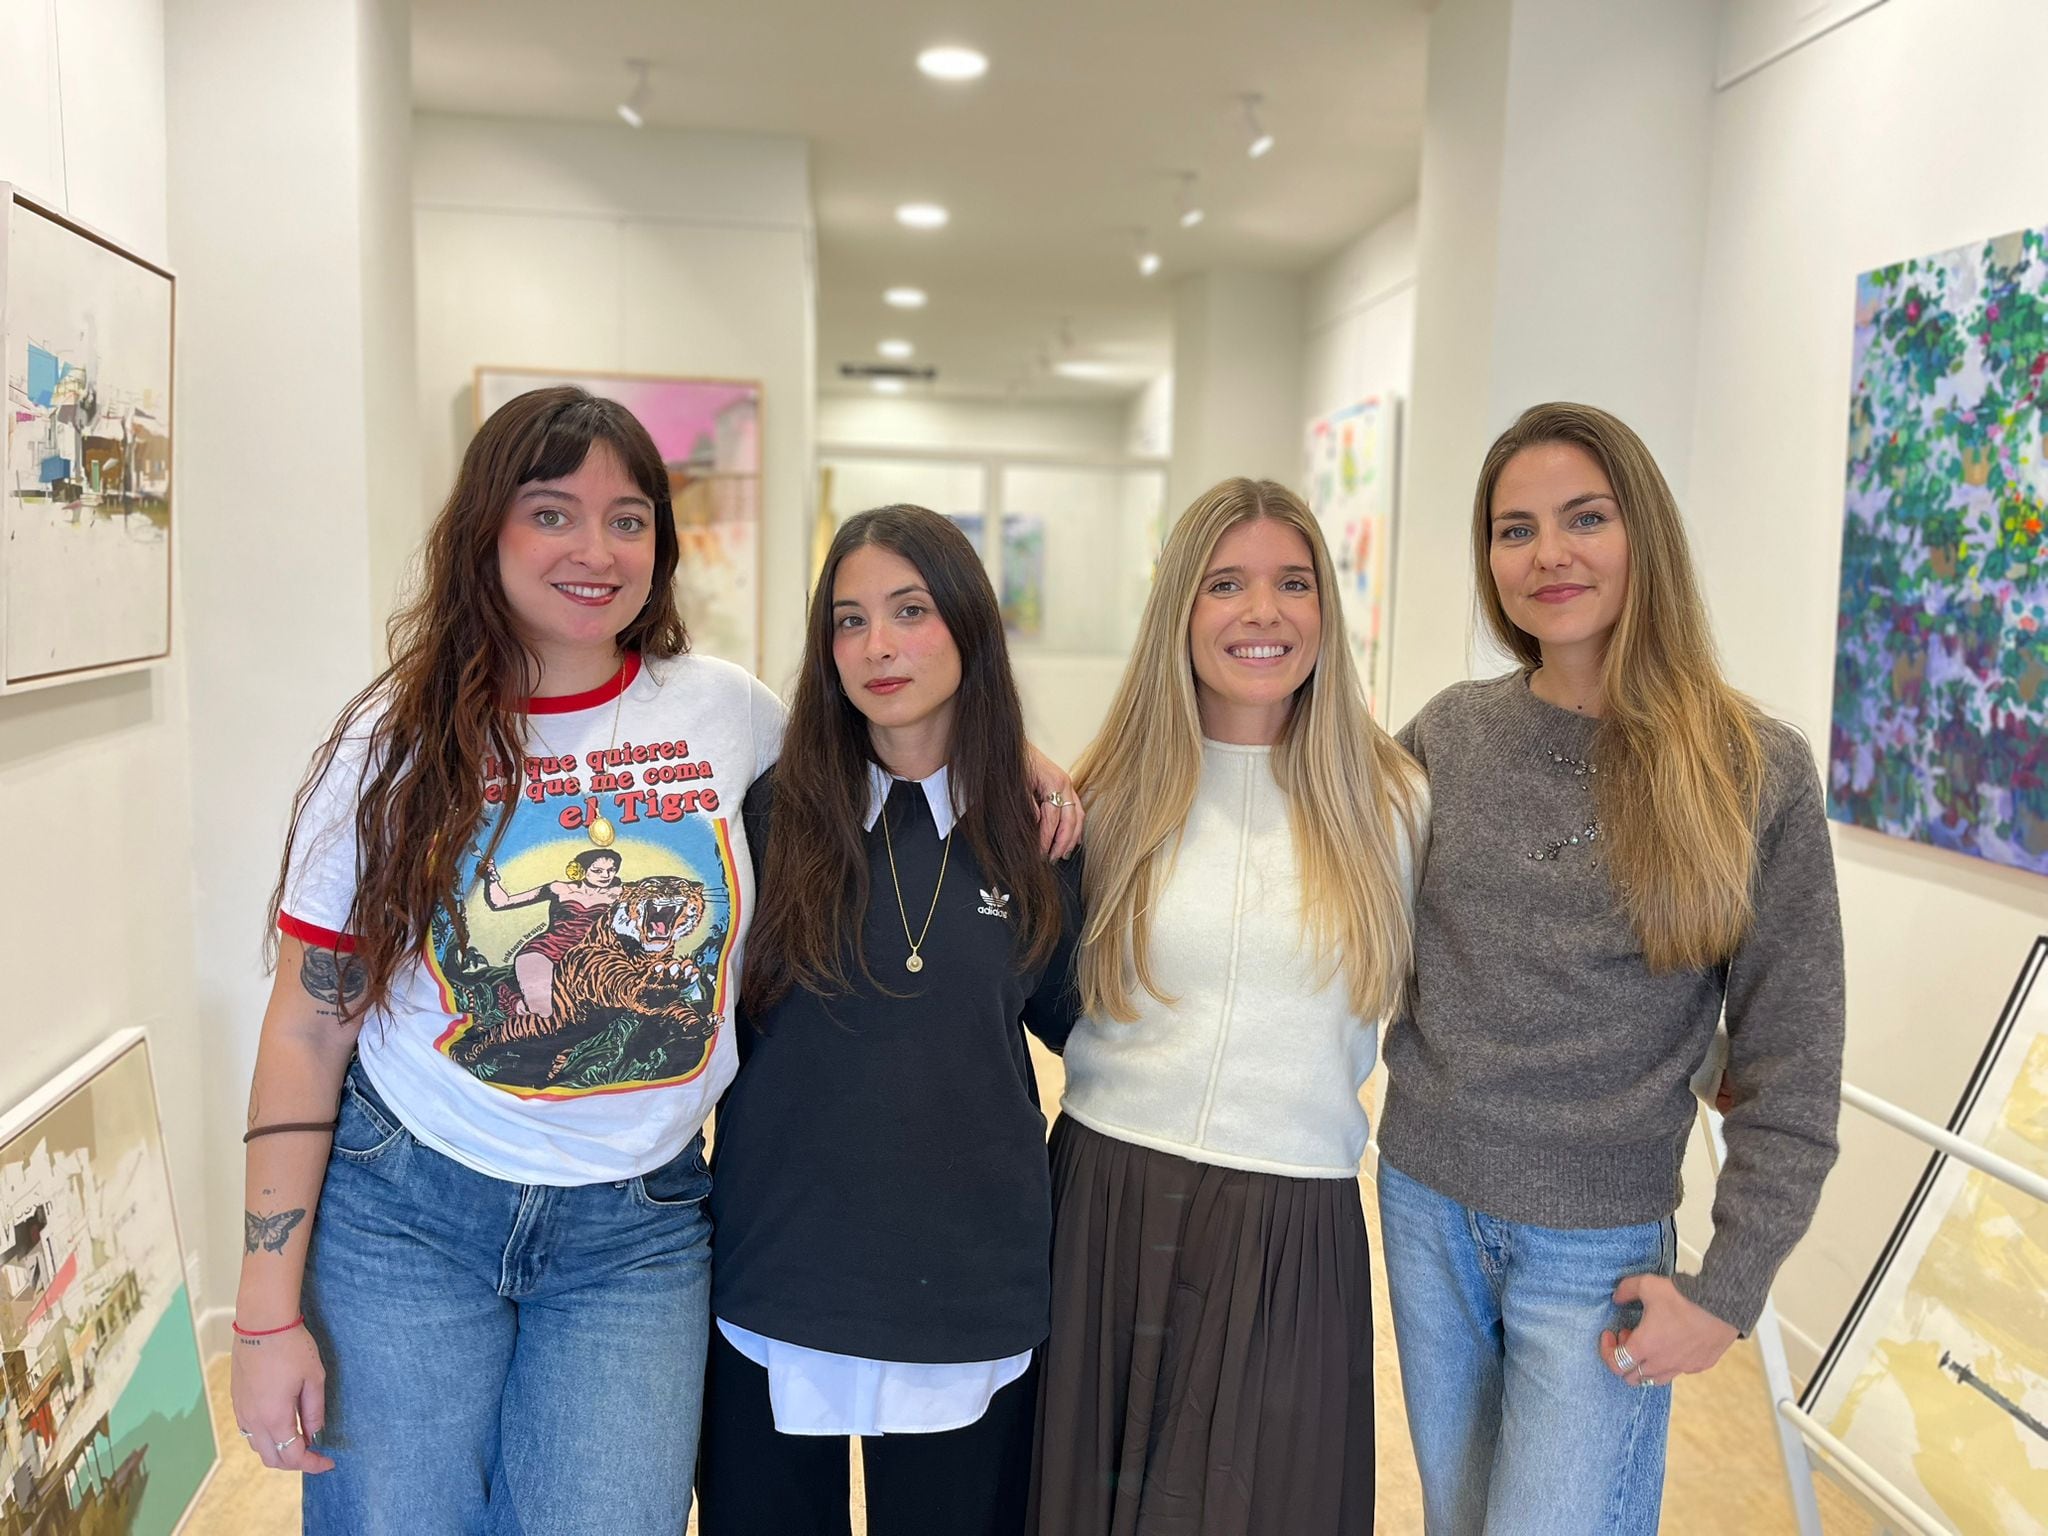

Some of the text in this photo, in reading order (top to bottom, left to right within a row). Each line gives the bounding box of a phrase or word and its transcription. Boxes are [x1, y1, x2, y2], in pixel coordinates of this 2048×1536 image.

[524, 754, 577, 783] que
[585, 740, 689, 773] quieres
[526, 776, 580, 804] que
[590, 771, 634, 793] me
[643, 760, 713, 785] coma
[558, 788, 719, 830] el Tigre
[977, 906, 1007, 919] adidas
